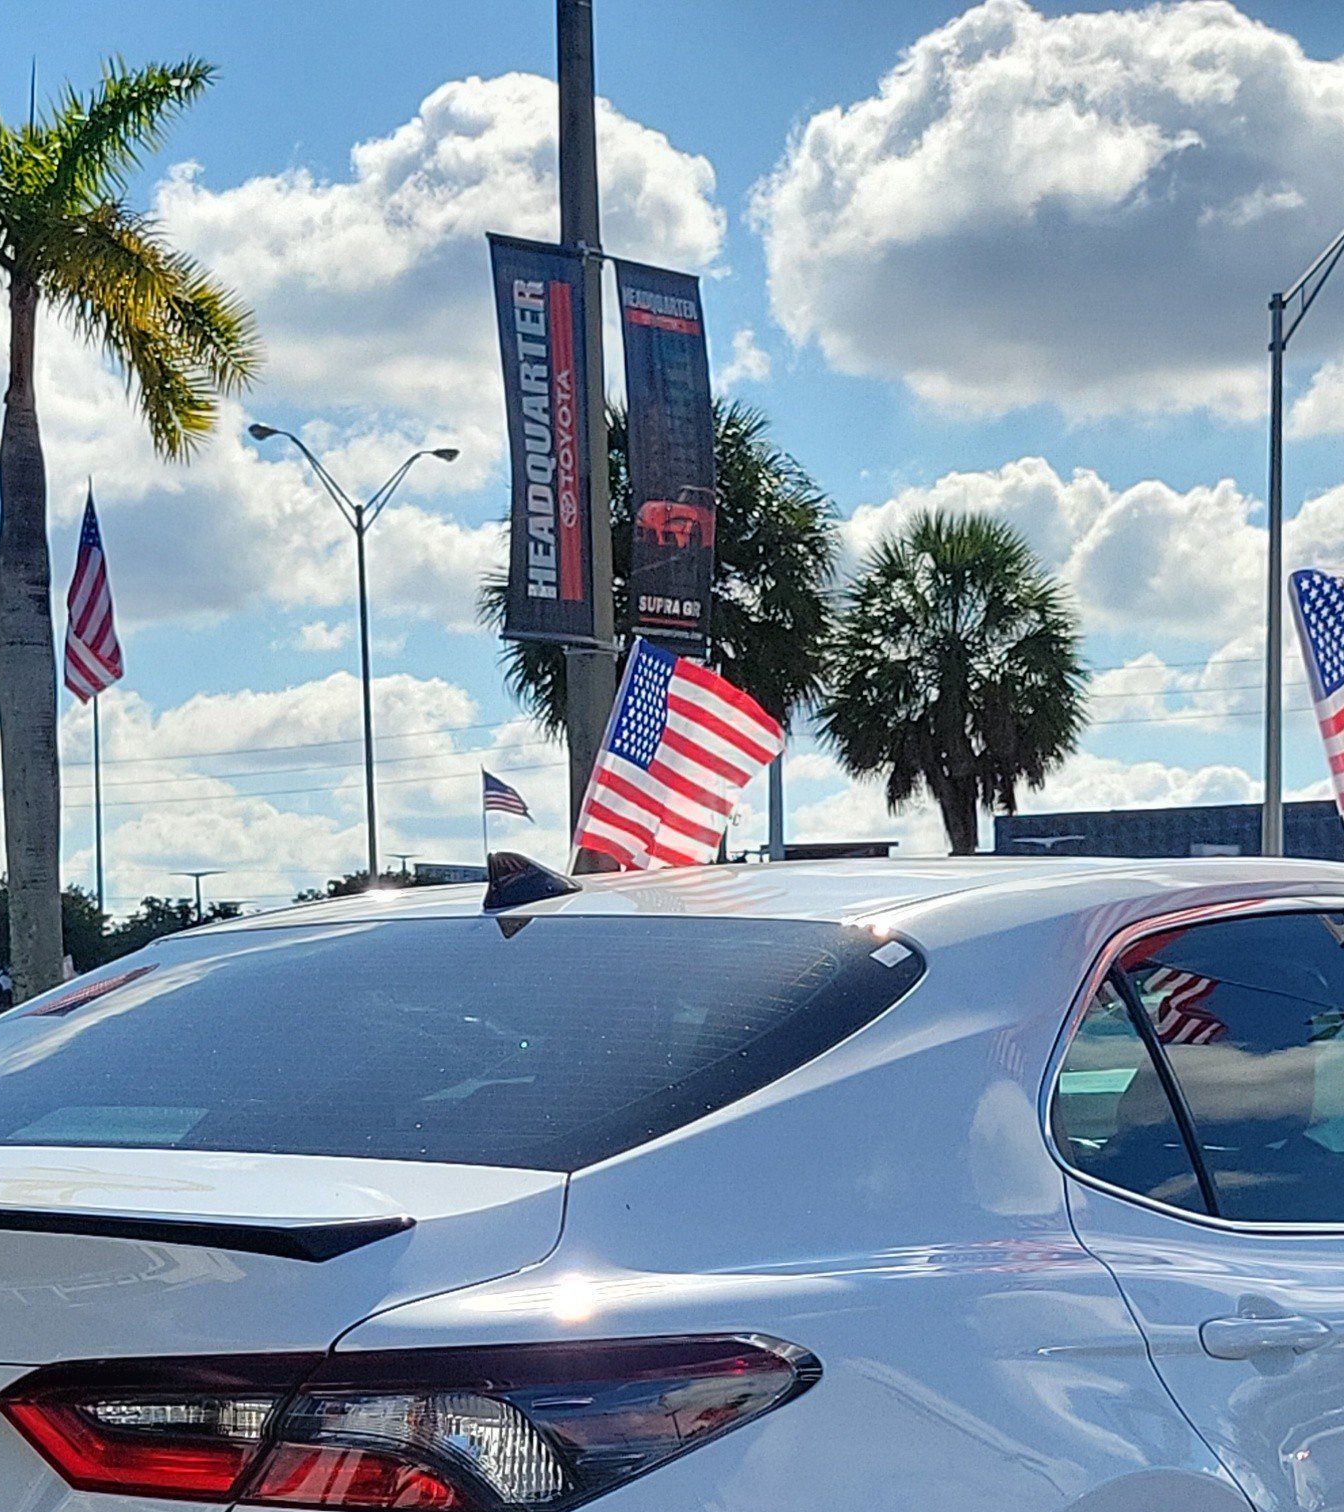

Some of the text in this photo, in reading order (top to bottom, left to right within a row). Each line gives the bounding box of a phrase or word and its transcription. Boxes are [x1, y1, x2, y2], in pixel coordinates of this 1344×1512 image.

[513, 279, 557, 600] HEADQUARTER
[557, 370, 574, 484] TOYOTA
[638, 595, 702, 618] SUPRA GR
